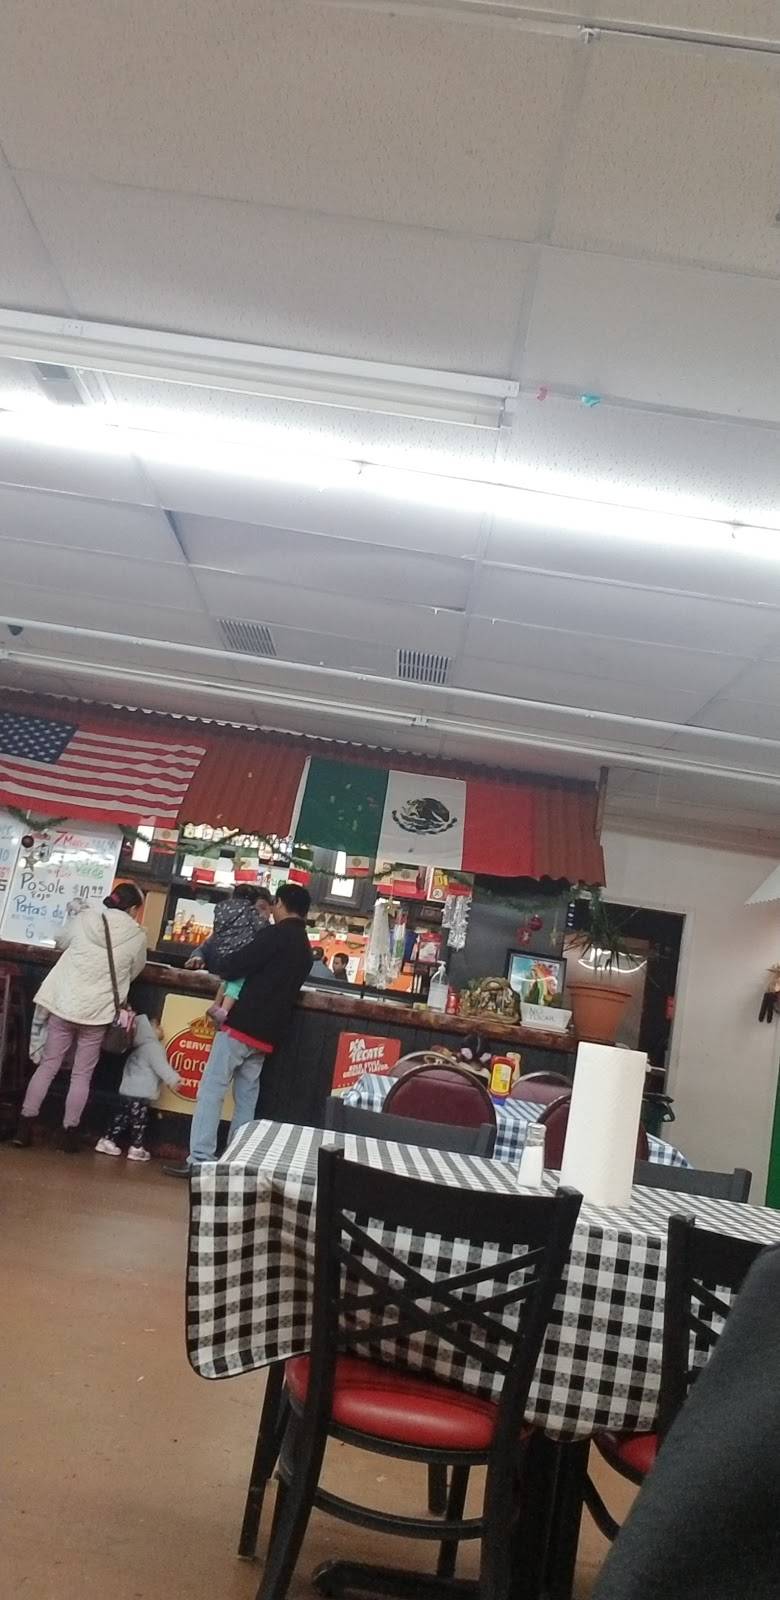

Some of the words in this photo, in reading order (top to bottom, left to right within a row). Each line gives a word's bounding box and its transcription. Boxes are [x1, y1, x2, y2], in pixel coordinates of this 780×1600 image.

[21, 872, 65, 894] Posole
[14, 895, 47, 915] Patas
[179, 1039, 211, 1052] CERVE
[169, 1050, 207, 1073] Coro
